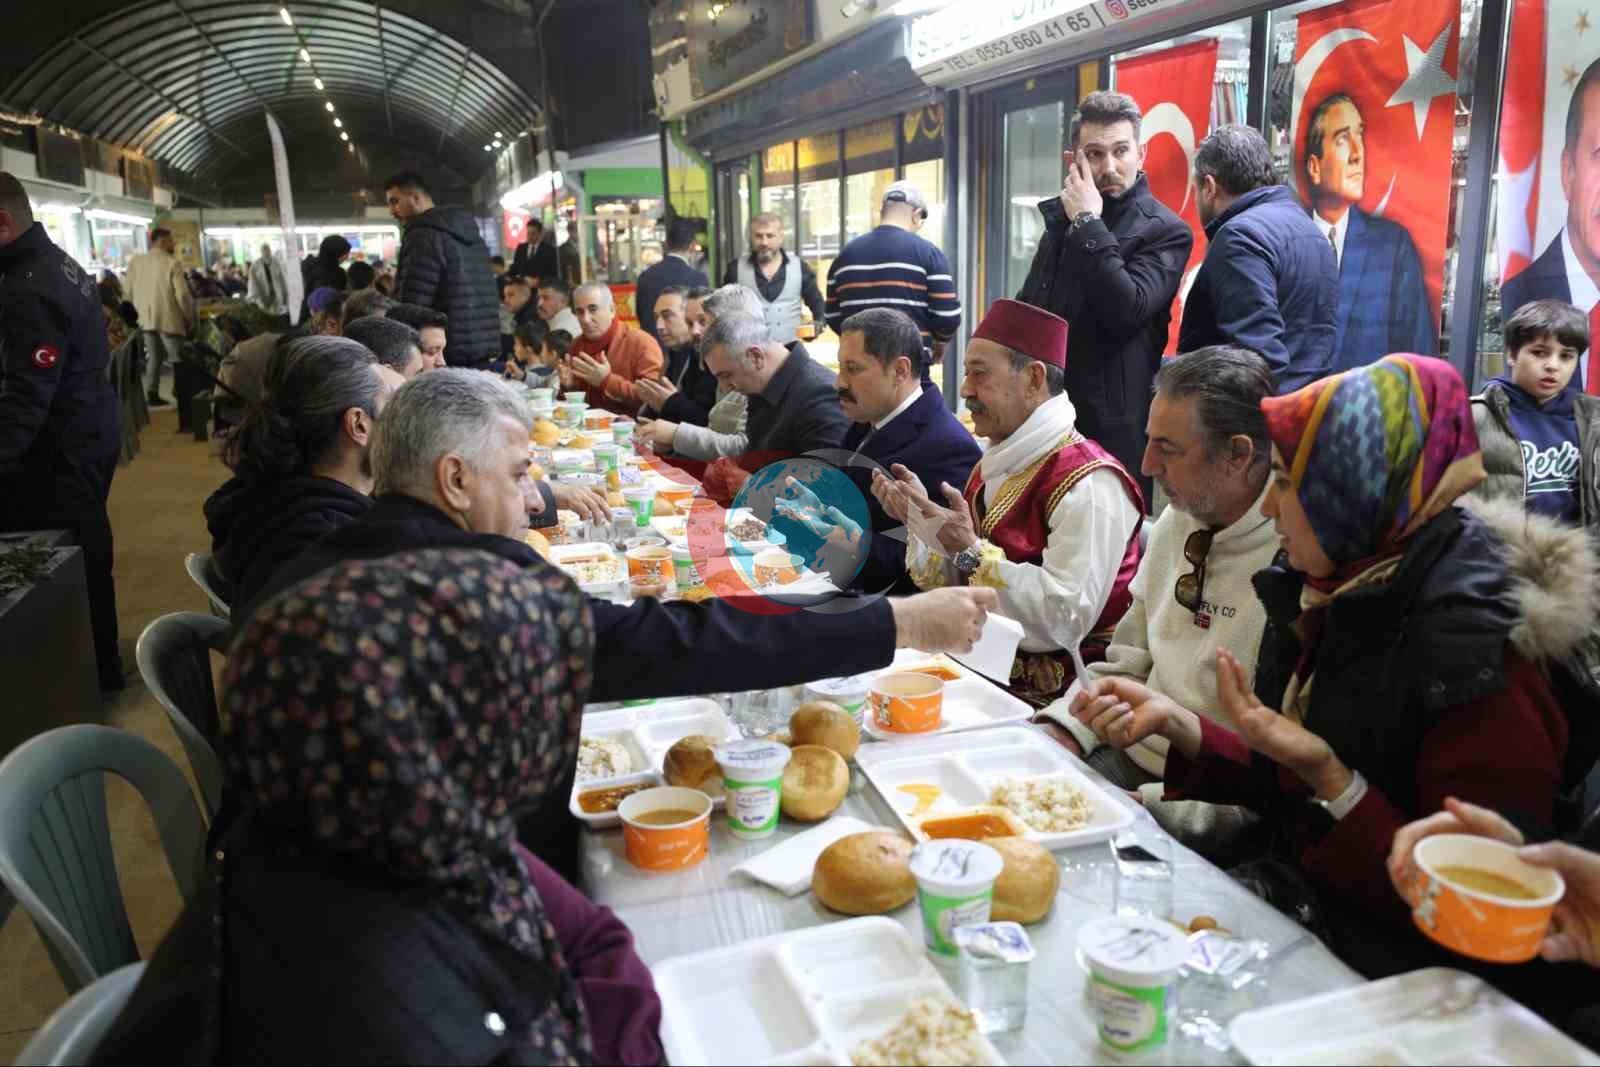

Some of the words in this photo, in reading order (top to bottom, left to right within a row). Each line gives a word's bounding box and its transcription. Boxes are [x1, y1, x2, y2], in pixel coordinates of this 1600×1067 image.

[976, 41, 1010, 62] 0552
[1012, 29, 1043, 51] 660
[1044, 20, 1065, 41] 41
[1066, 11, 1091, 33] 65
